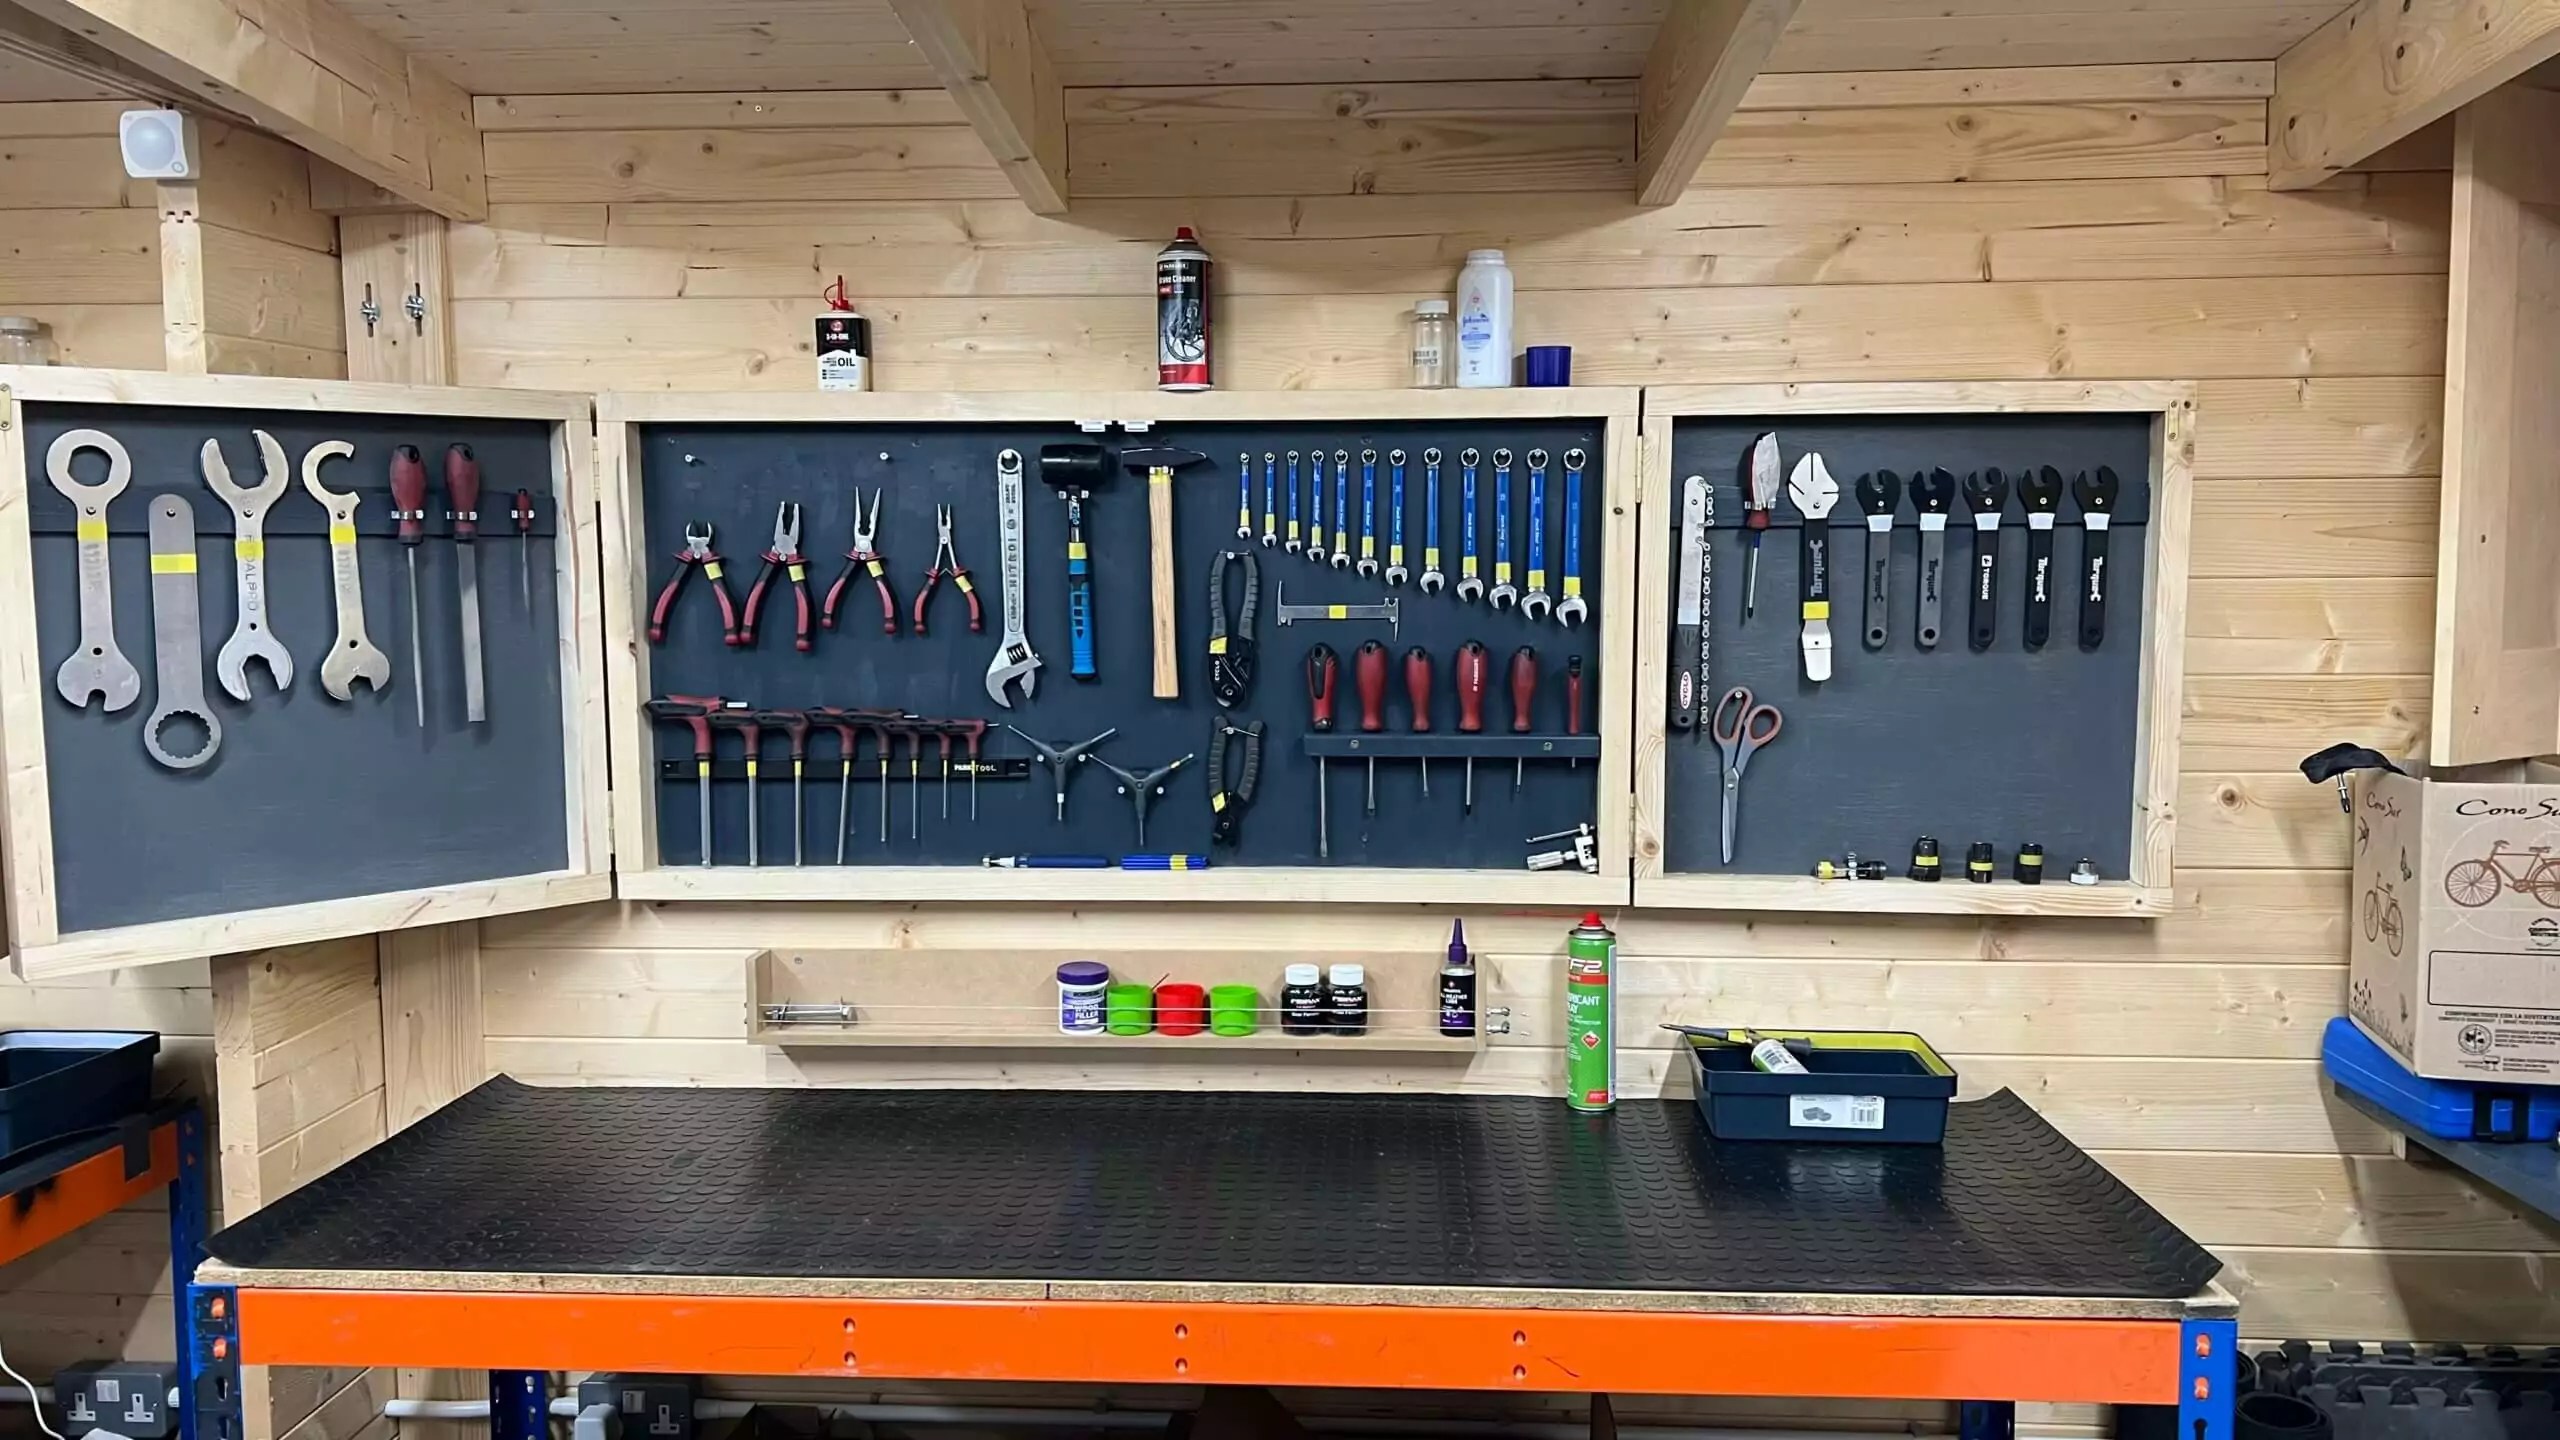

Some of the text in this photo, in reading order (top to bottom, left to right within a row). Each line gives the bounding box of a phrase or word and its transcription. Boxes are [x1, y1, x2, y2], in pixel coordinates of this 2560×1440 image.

[837, 357, 856, 367] OIL
[1982, 567, 1990, 600] TORQUE
[2456, 798, 2560, 820] Cono Su
